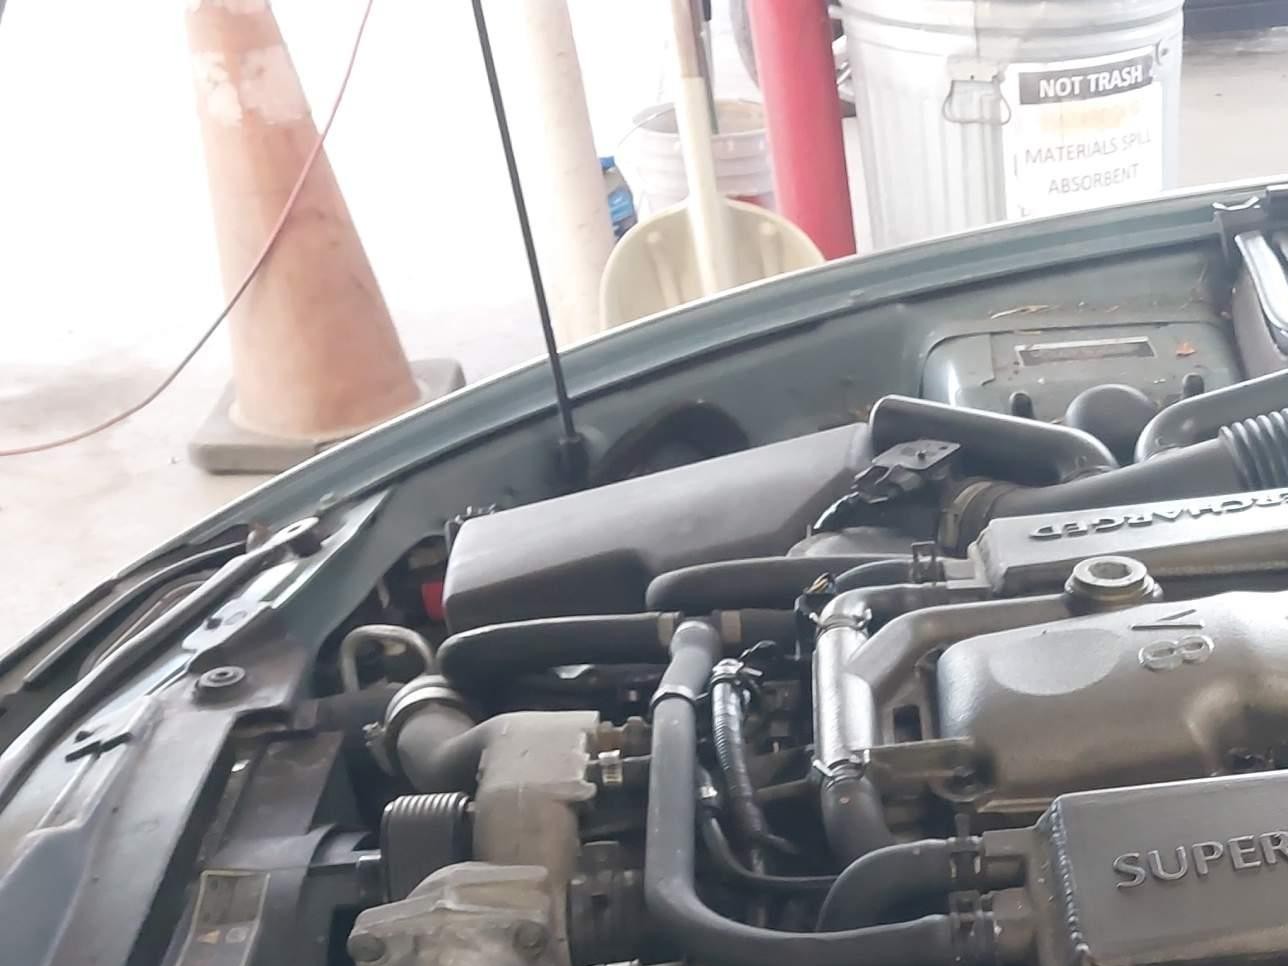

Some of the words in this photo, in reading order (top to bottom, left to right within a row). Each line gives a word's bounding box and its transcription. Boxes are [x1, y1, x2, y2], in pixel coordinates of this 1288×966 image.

[1040, 76, 1083, 98] NOT
[1087, 65, 1144, 92] TRASH
[1025, 137, 1118, 164] MATERIALS
[1048, 163, 1140, 194] ABSORBENT
[1129, 608, 1215, 672] V8
